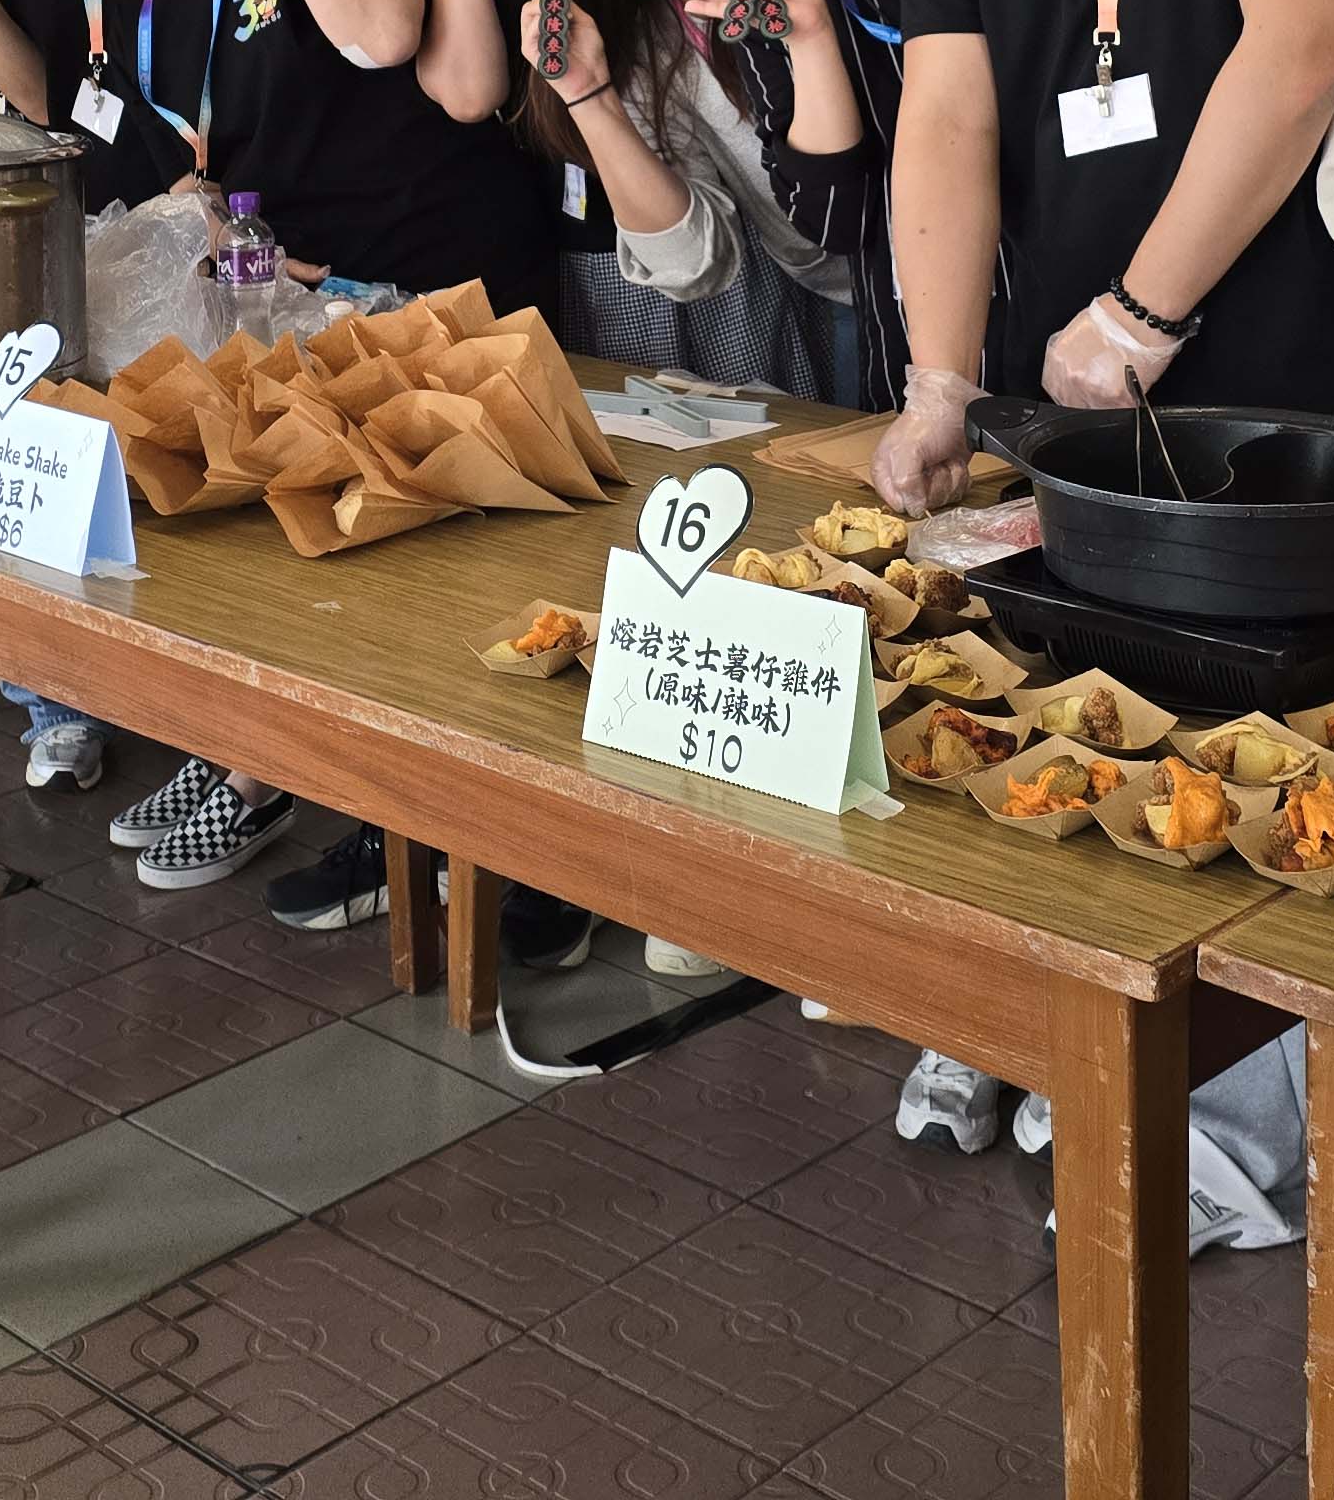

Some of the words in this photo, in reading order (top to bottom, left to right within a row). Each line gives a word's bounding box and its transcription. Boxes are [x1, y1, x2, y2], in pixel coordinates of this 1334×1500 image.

[24, 445, 68, 479] Shake
[660, 497, 711, 553] 16
[609, 617, 841, 706] 熔岩芝士薯仔雞件
[644, 666, 792, 738] (原味/辣味)
[679, 719, 743, 774] $10
